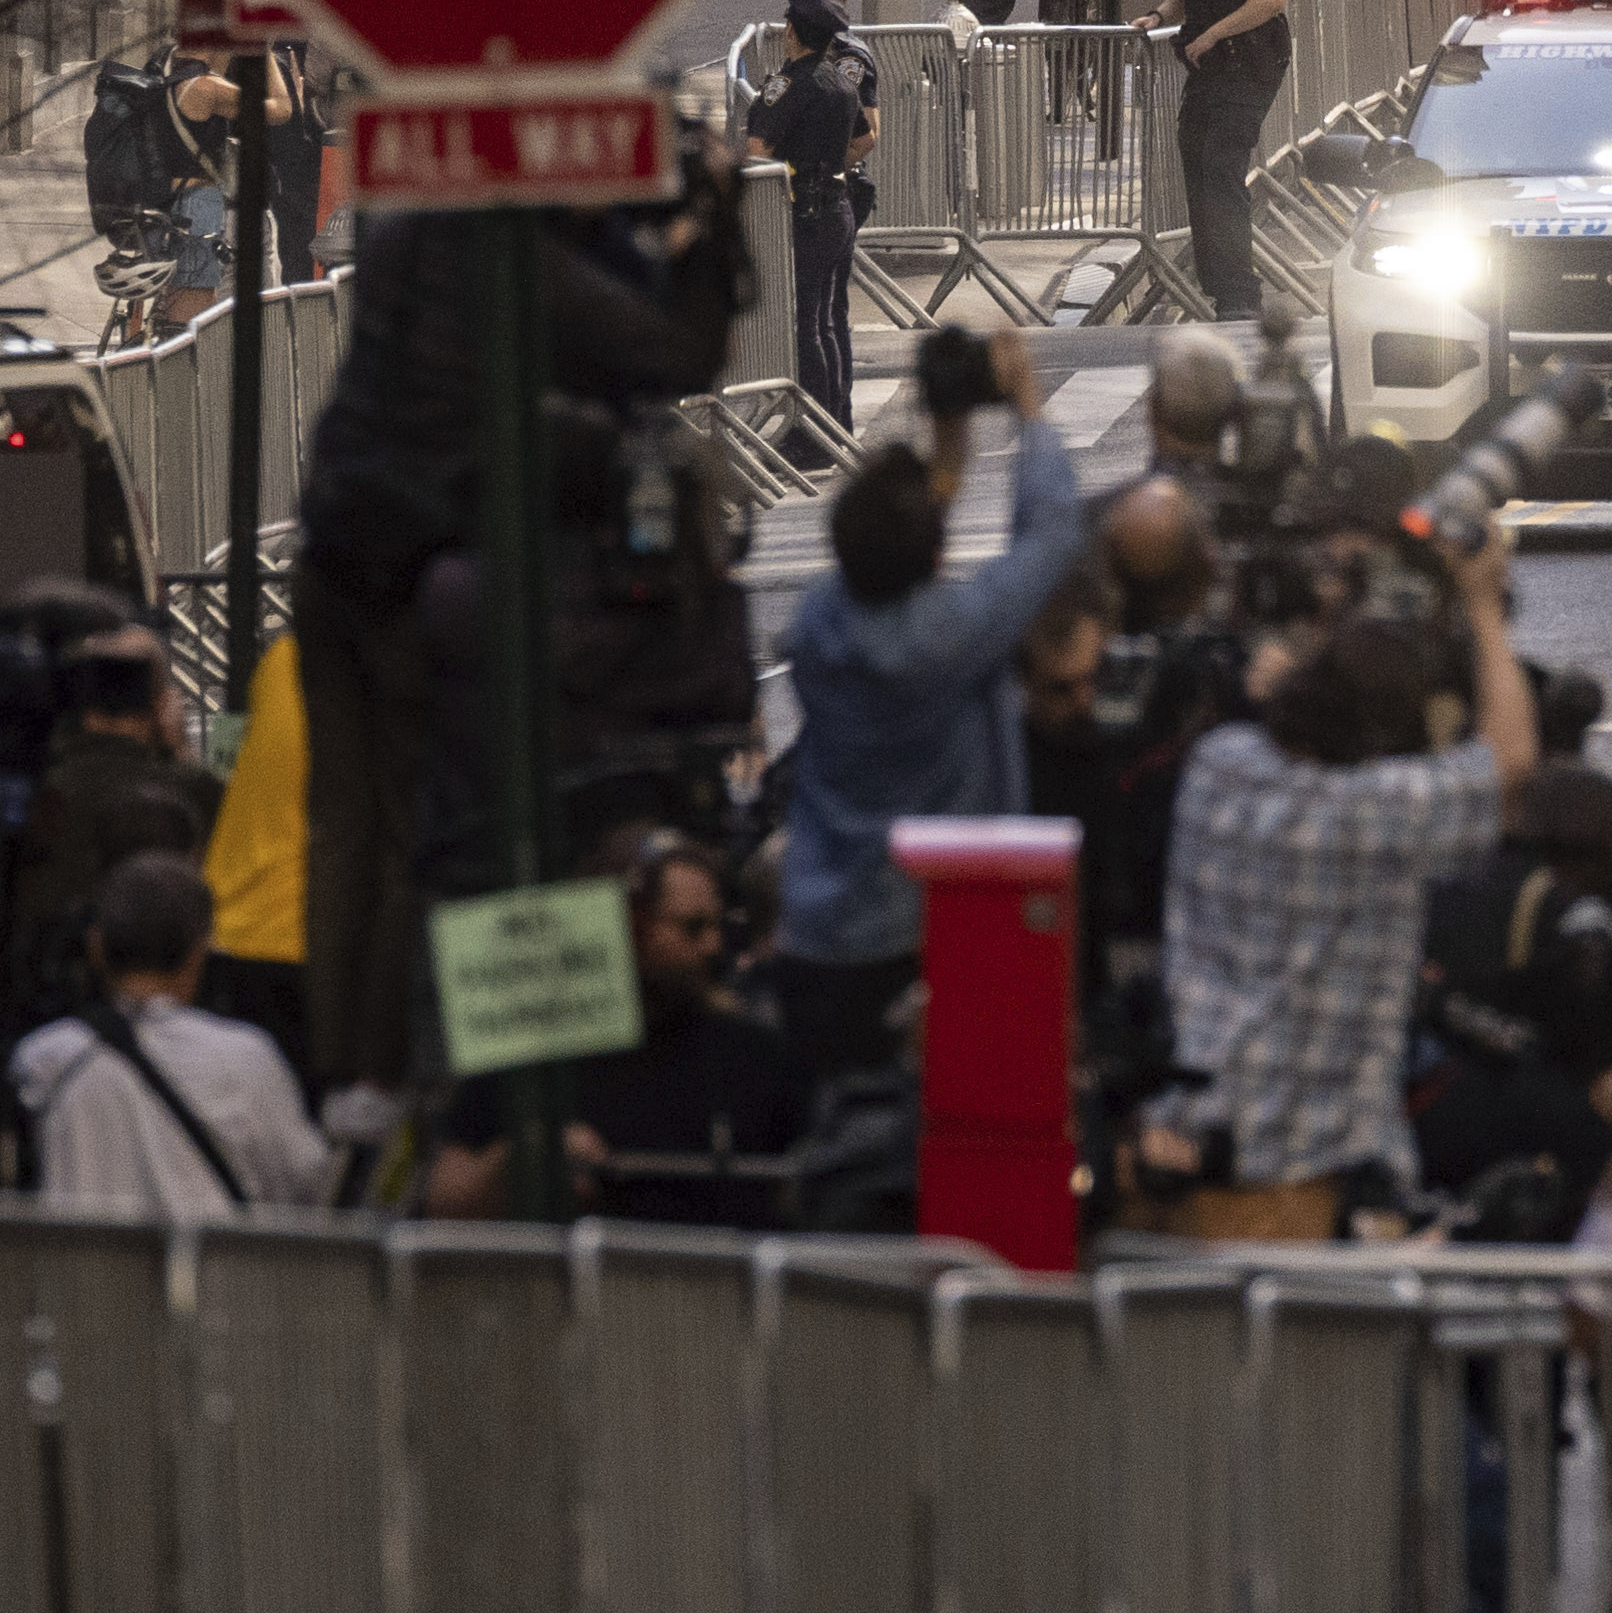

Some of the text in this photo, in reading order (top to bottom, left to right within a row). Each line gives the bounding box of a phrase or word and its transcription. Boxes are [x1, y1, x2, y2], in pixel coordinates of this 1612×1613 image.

[369, 106, 646, 182] ALL WAY
[1509, 216, 1608, 236] NYPD
